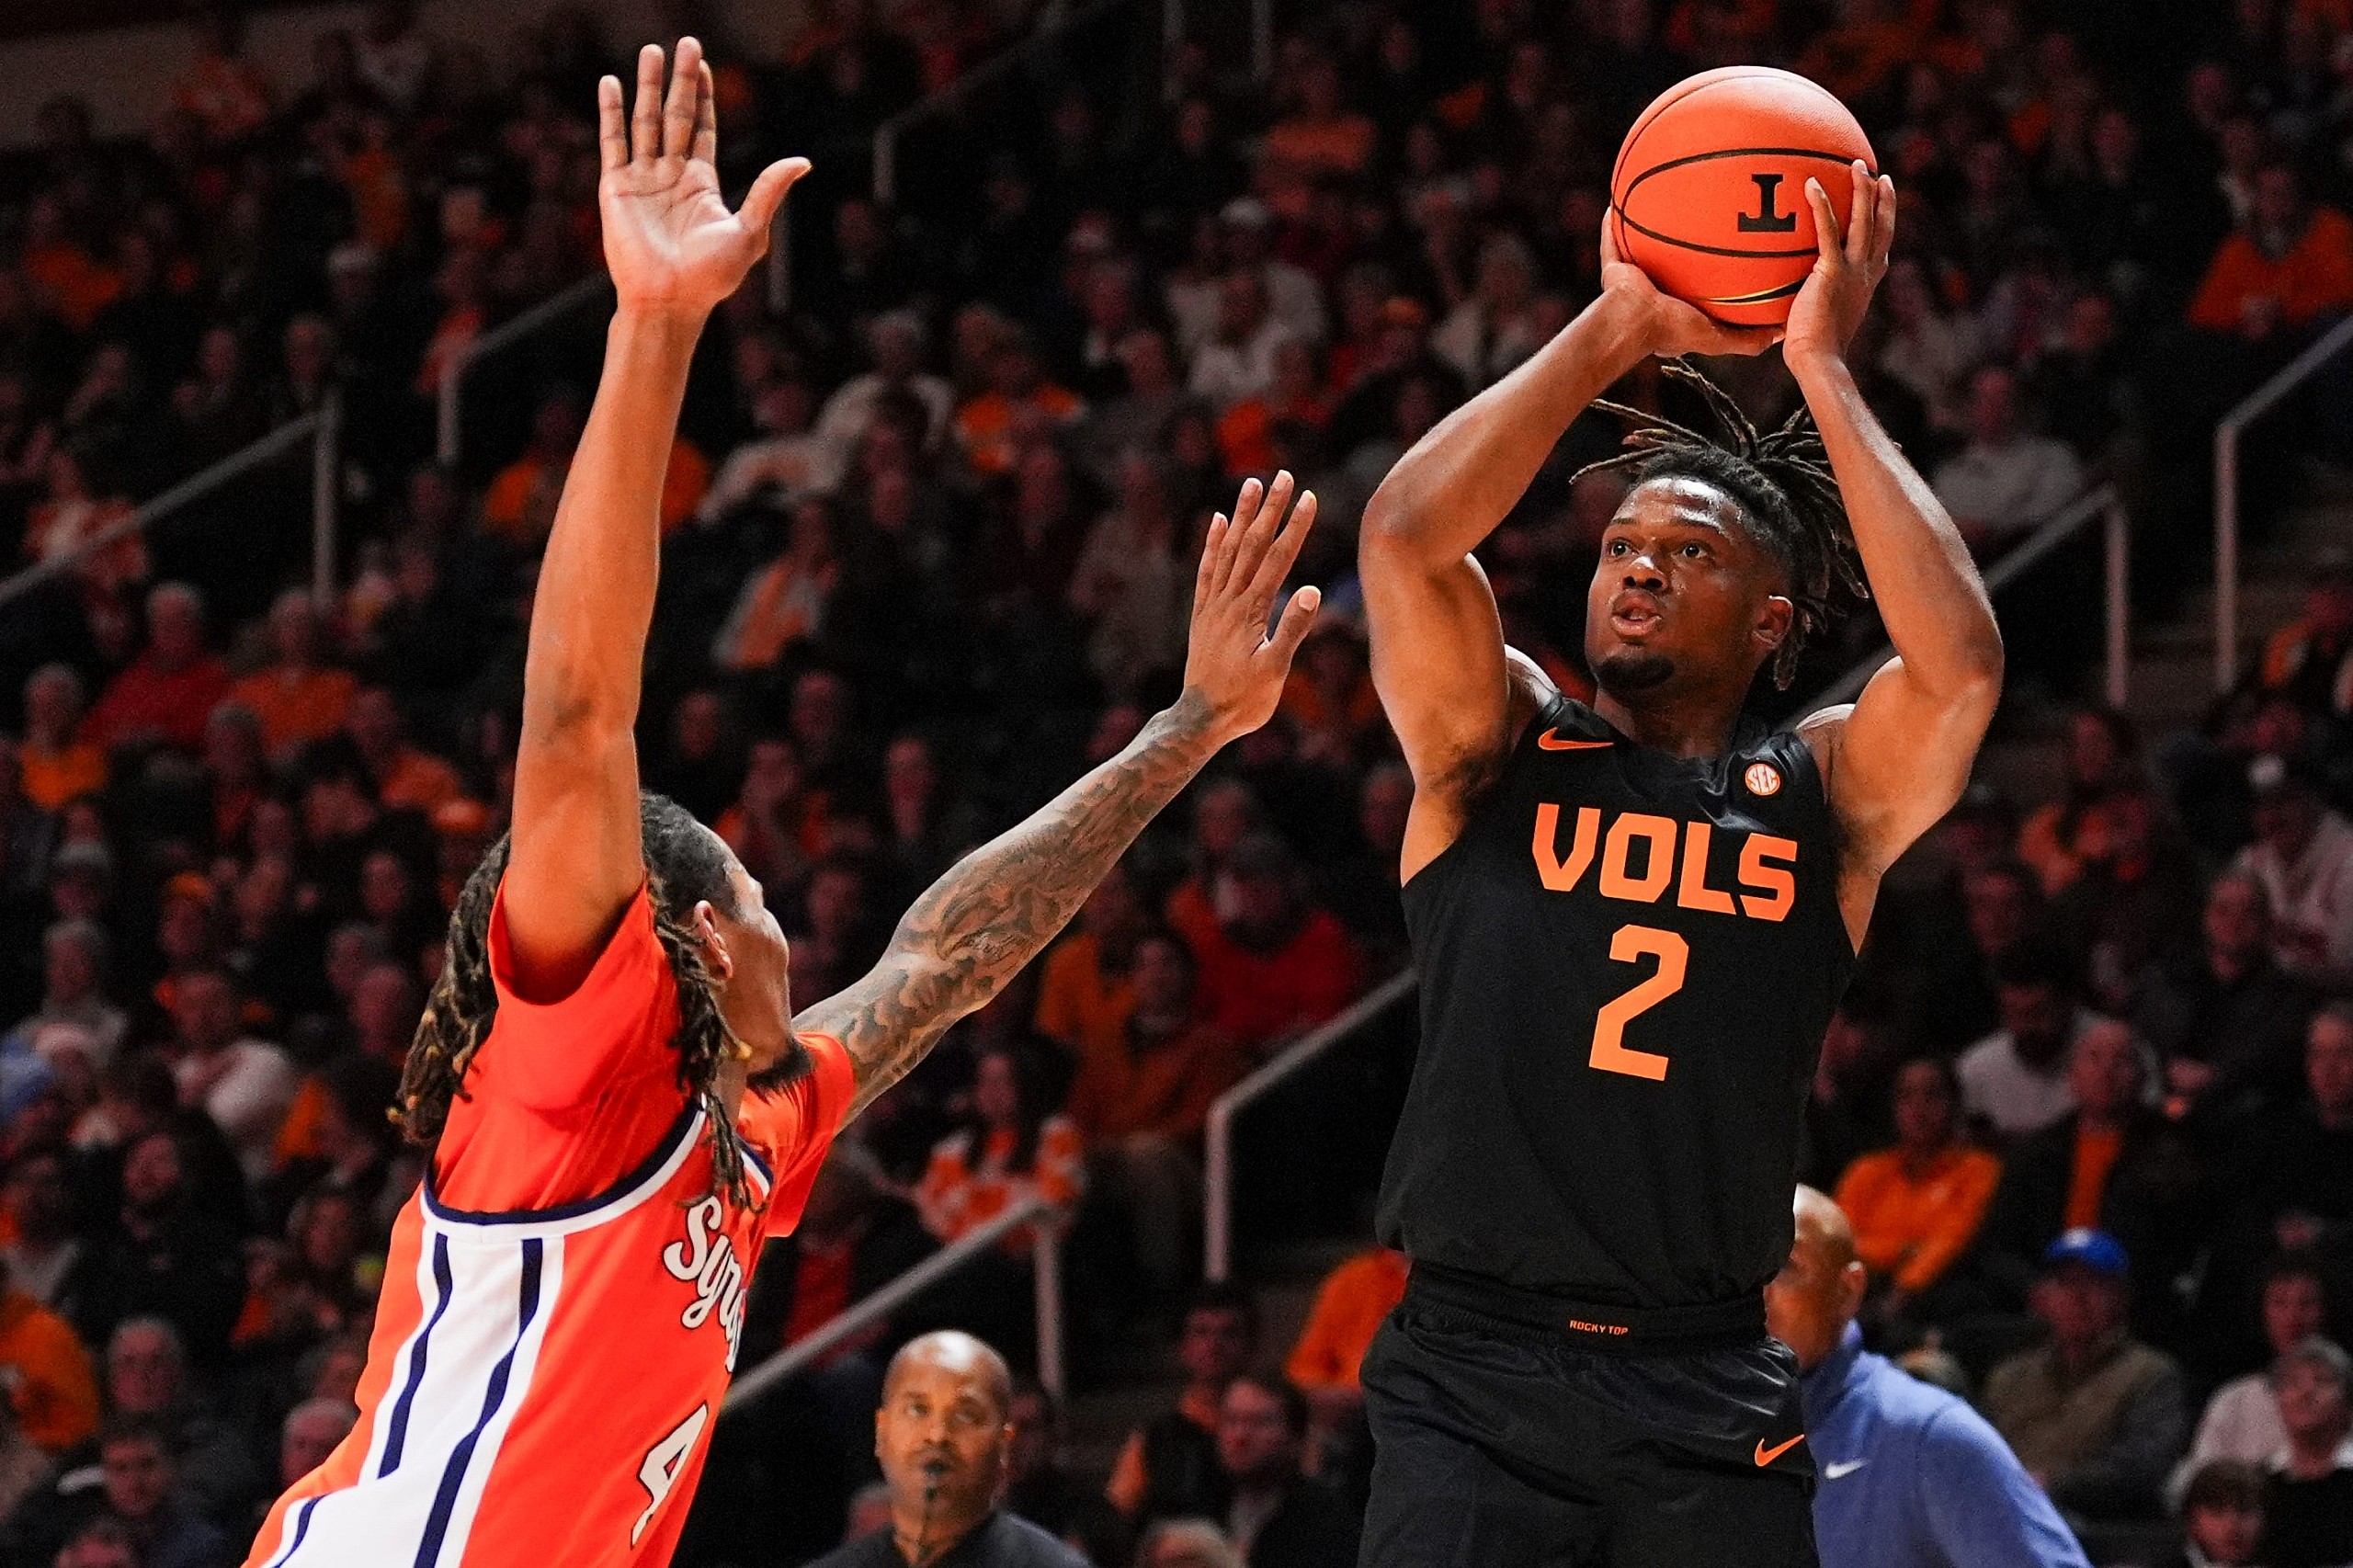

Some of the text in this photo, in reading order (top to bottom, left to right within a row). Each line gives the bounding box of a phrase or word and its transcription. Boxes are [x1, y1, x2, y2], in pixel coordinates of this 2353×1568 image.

[1738, 174, 1796, 232] T
[1747, 764, 1778, 793] SEC
[1532, 802, 1797, 922] VOLS
[1589, 924, 1689, 1081] 2
[1569, 1319, 1629, 1335] ROCKY TOP
[631, 1401, 709, 1550] 4
